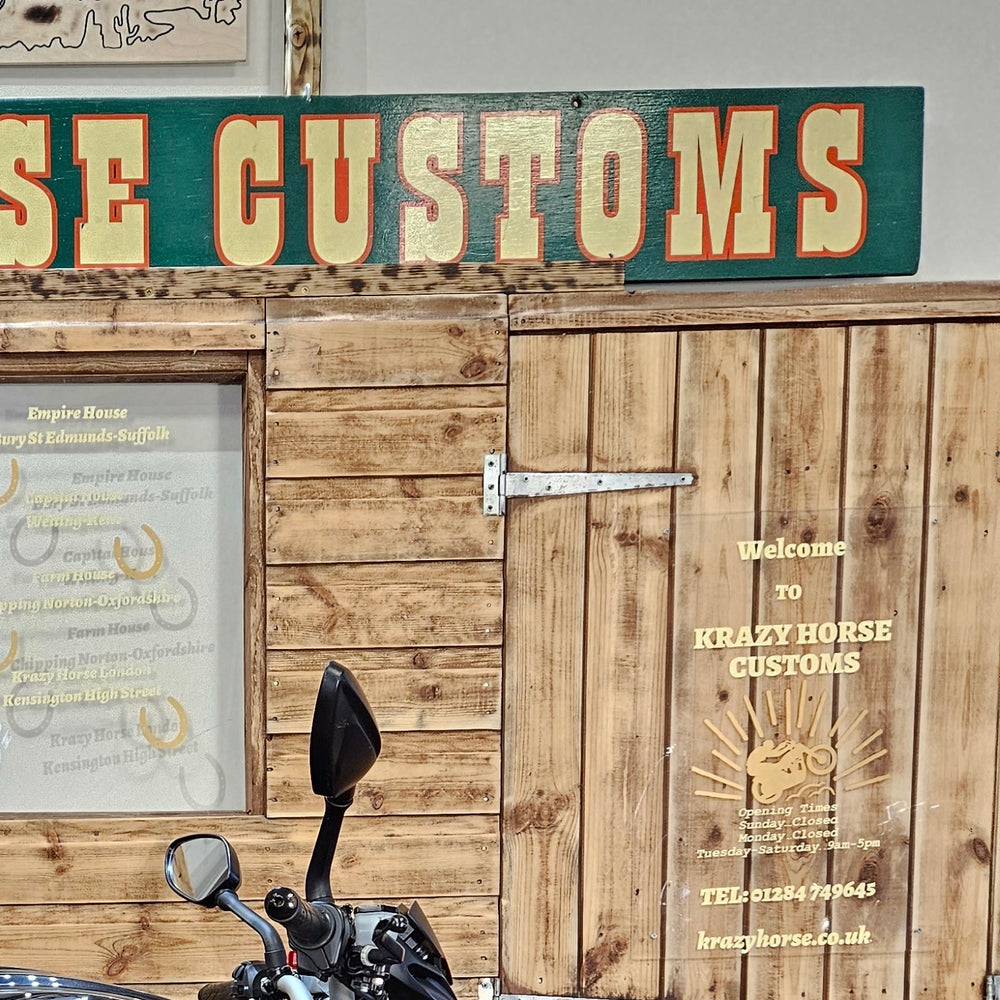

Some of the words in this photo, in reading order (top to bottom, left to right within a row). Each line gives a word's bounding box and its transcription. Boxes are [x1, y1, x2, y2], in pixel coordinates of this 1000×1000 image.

[212, 103, 868, 265] CUSTOMS
[27, 406, 81, 423] Empire
[82, 405, 128, 420] House
[27, 430, 44, 445] St
[45, 425, 170, 446] Edmunds-Suffolk
[737, 538, 847, 561] Welcome
[775, 583, 803, 601] TO
[693, 624, 793, 651] KRAZY
[795, 619, 893, 645] HORSE
[728, 651, 861, 679] CUSTOMS
[11, 668, 55, 685] Krazy
[56, 666, 97, 681] Horse
[2, 690, 83, 708] Kensington
[84, 688, 118, 706] High
[738, 806, 793, 818] Opening
[799, 803, 838, 813] Times
[792, 815, 839, 827] Closed
[792, 828, 839, 840] Closed
[827, 838, 881, 850] 9am-5pm
[809, 880, 877, 901] 749645
[696, 925, 872, 954] krazyhorse.co.uk
